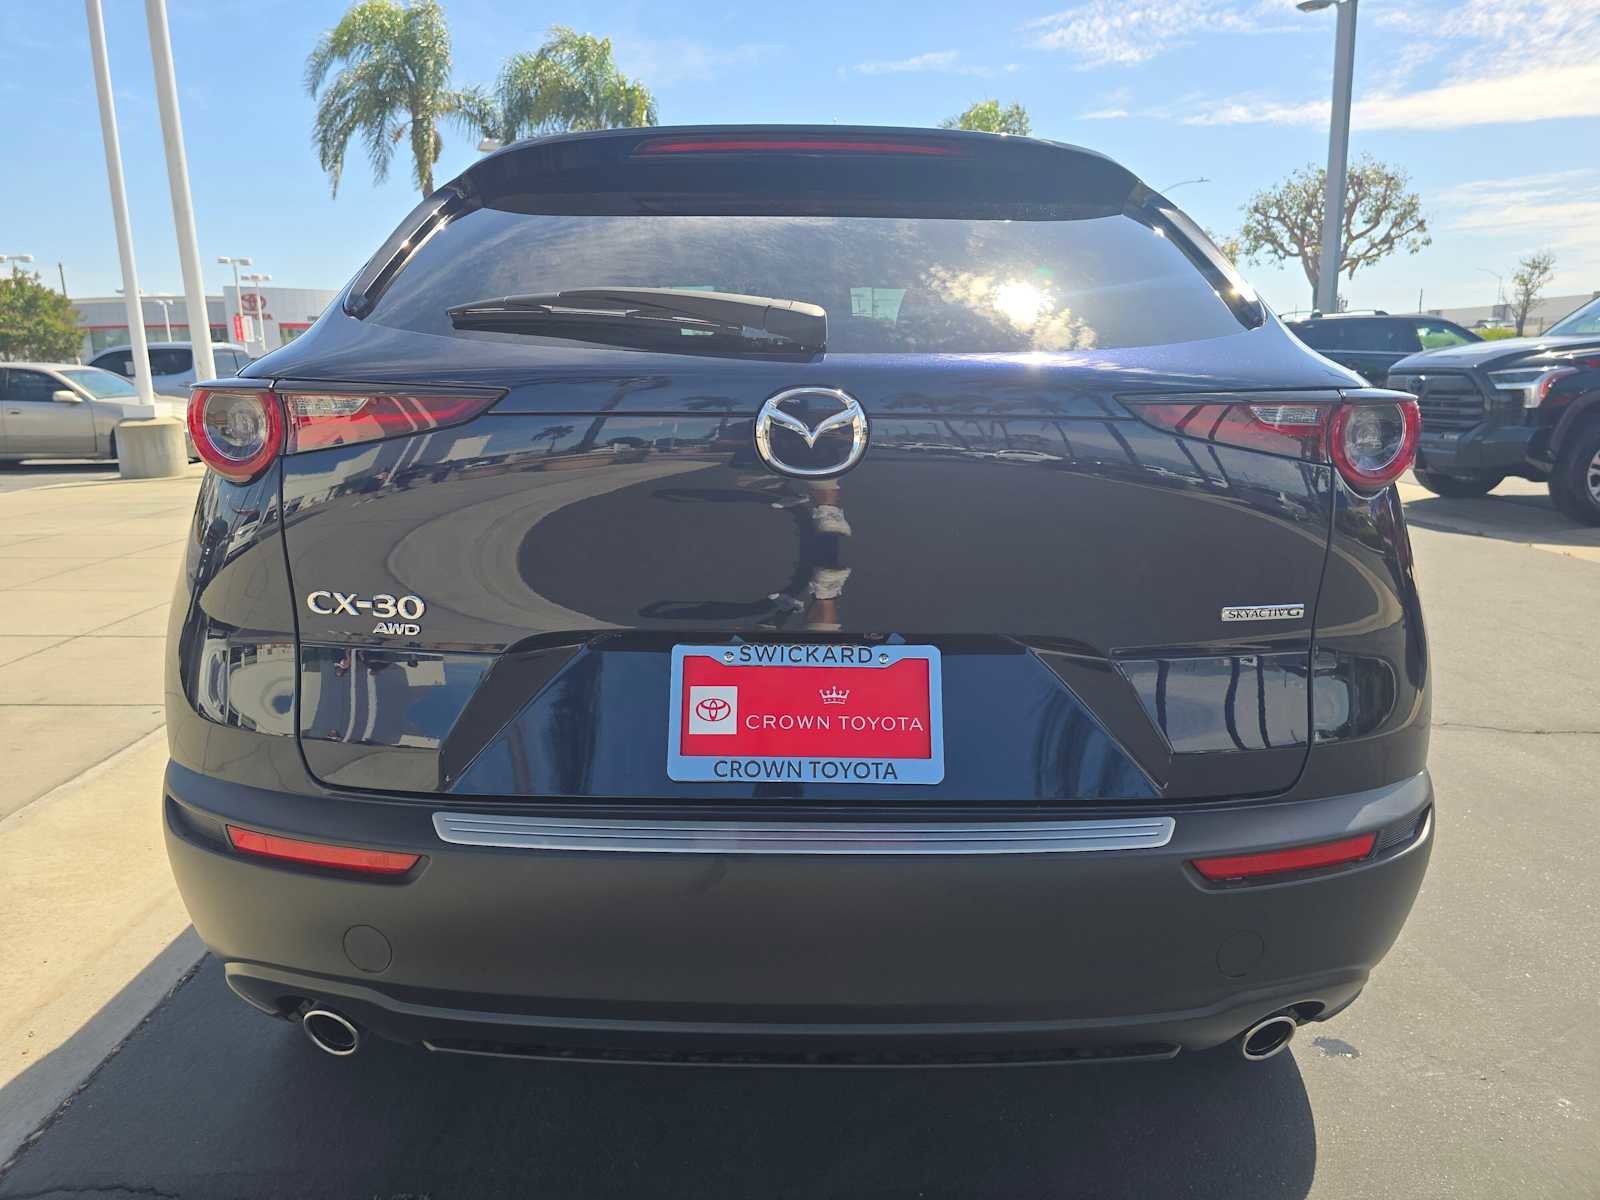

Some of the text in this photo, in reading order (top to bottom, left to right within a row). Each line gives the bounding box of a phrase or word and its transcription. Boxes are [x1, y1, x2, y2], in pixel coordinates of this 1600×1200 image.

[307, 590, 426, 620] CX-30
[372, 622, 421, 636] AWD
[740, 645, 873, 664] SWICKARD
[745, 714, 924, 732] CROWN TOYOTA
[714, 760, 898, 781] CROWN TOYOTA
